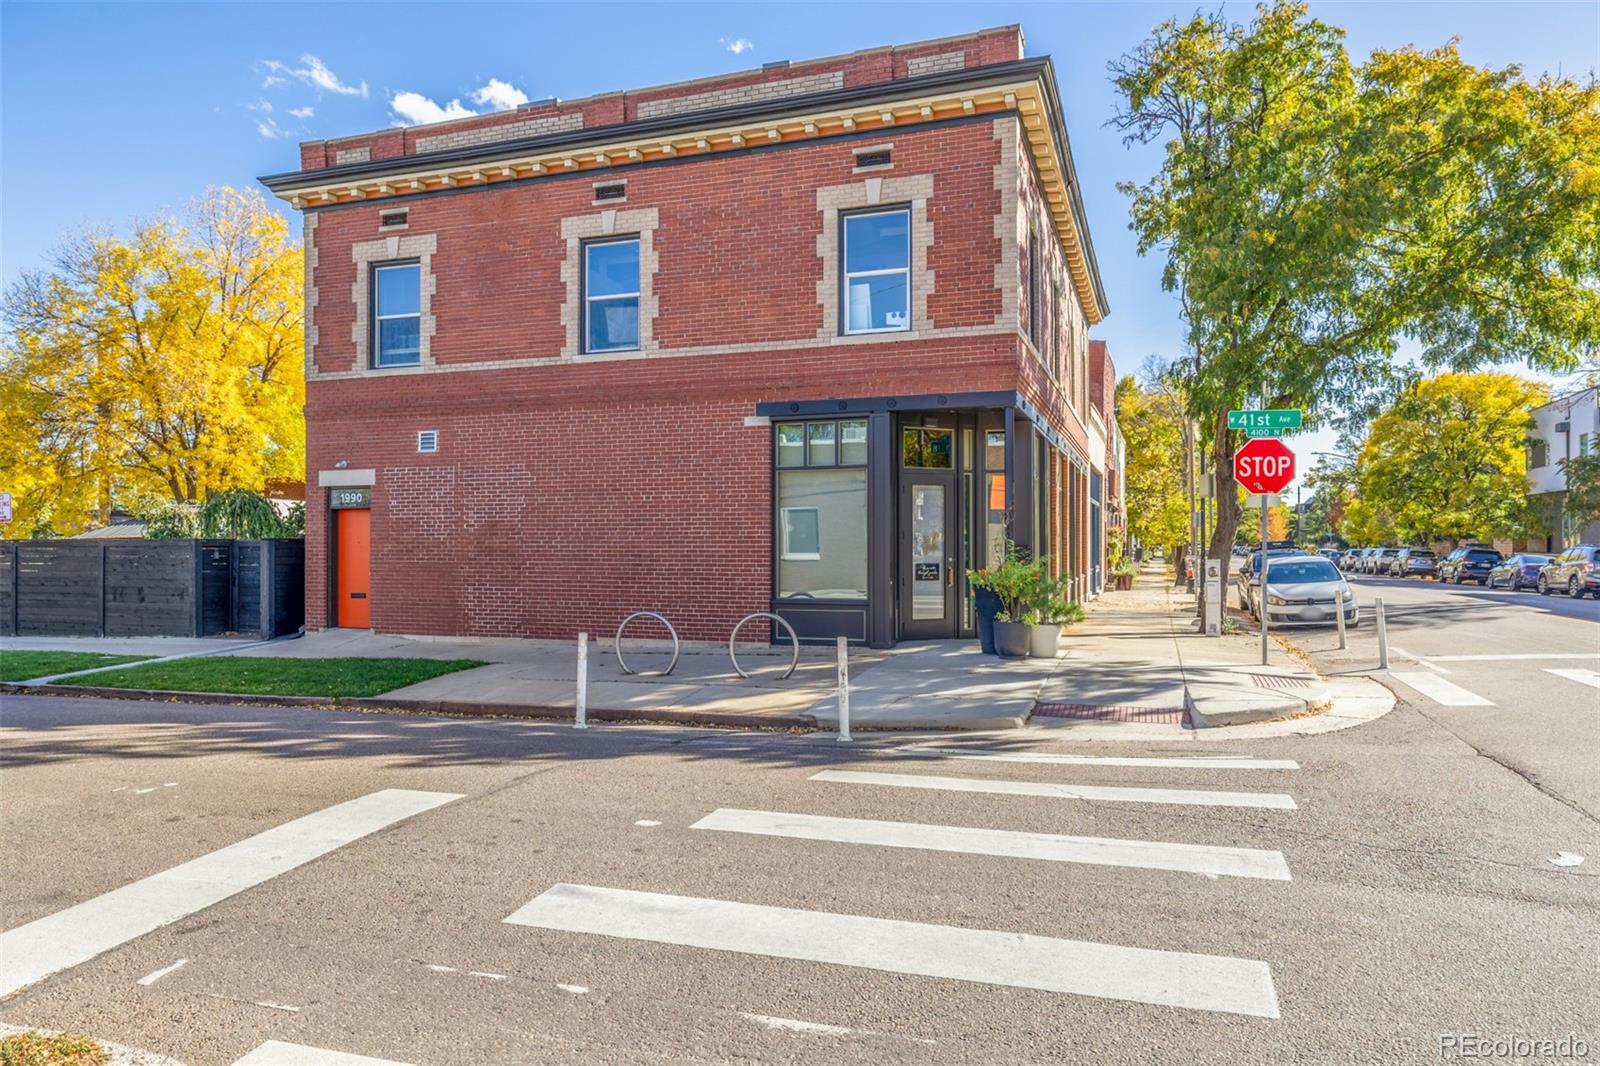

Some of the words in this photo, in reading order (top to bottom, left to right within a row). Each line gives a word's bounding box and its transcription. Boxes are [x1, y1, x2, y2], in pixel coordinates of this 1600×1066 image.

[1238, 413, 1270, 426] 41st
[1239, 456, 1291, 477] STOP
[340, 493, 362, 503] 1990
